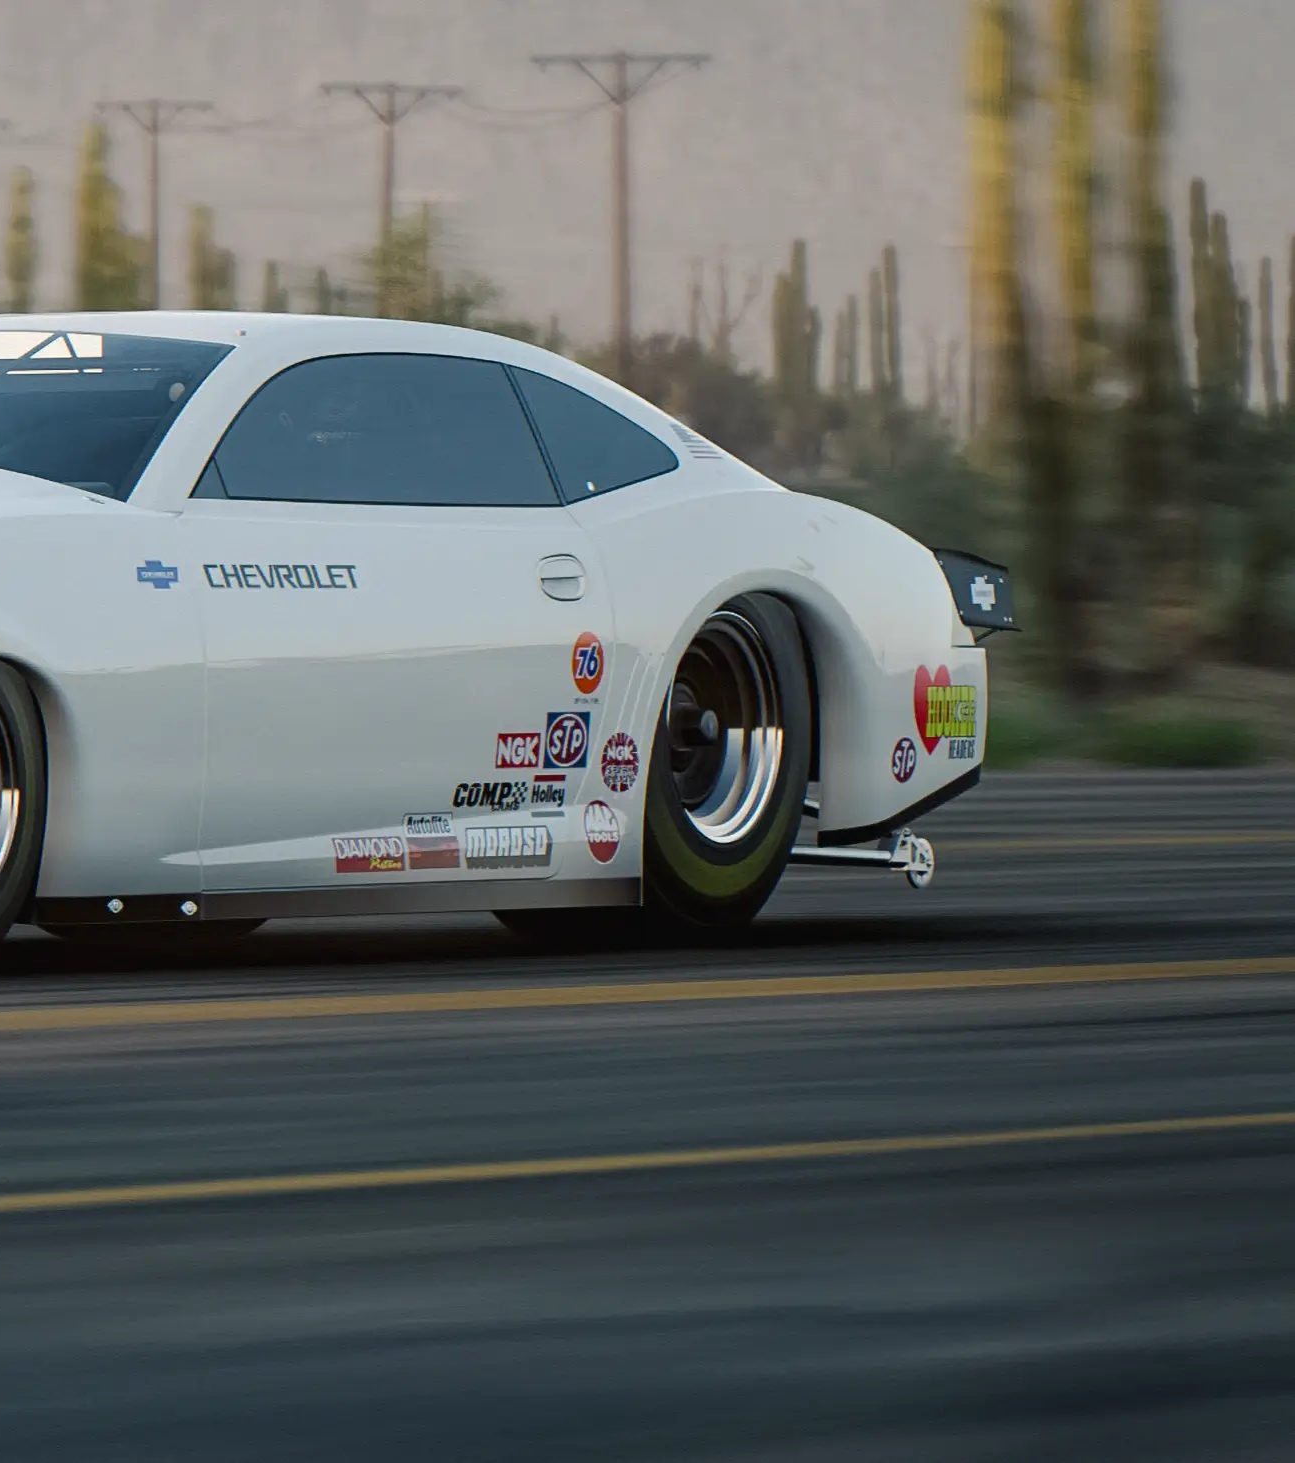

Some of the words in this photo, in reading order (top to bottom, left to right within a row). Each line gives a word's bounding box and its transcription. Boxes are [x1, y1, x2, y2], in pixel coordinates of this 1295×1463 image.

[203, 564, 358, 589] CHEVROLET
[575, 642, 600, 681] 76
[497, 736, 539, 766] NGK
[551, 719, 583, 759] STP
[606, 745, 633, 761] NGK
[893, 740, 916, 778] STP
[453, 782, 513, 808] COMP
[531, 784, 565, 808] Holley
[407, 816, 451, 835] Autolite
[588, 831, 619, 843] TOOLS
[334, 837, 404, 859] DIAMOND
